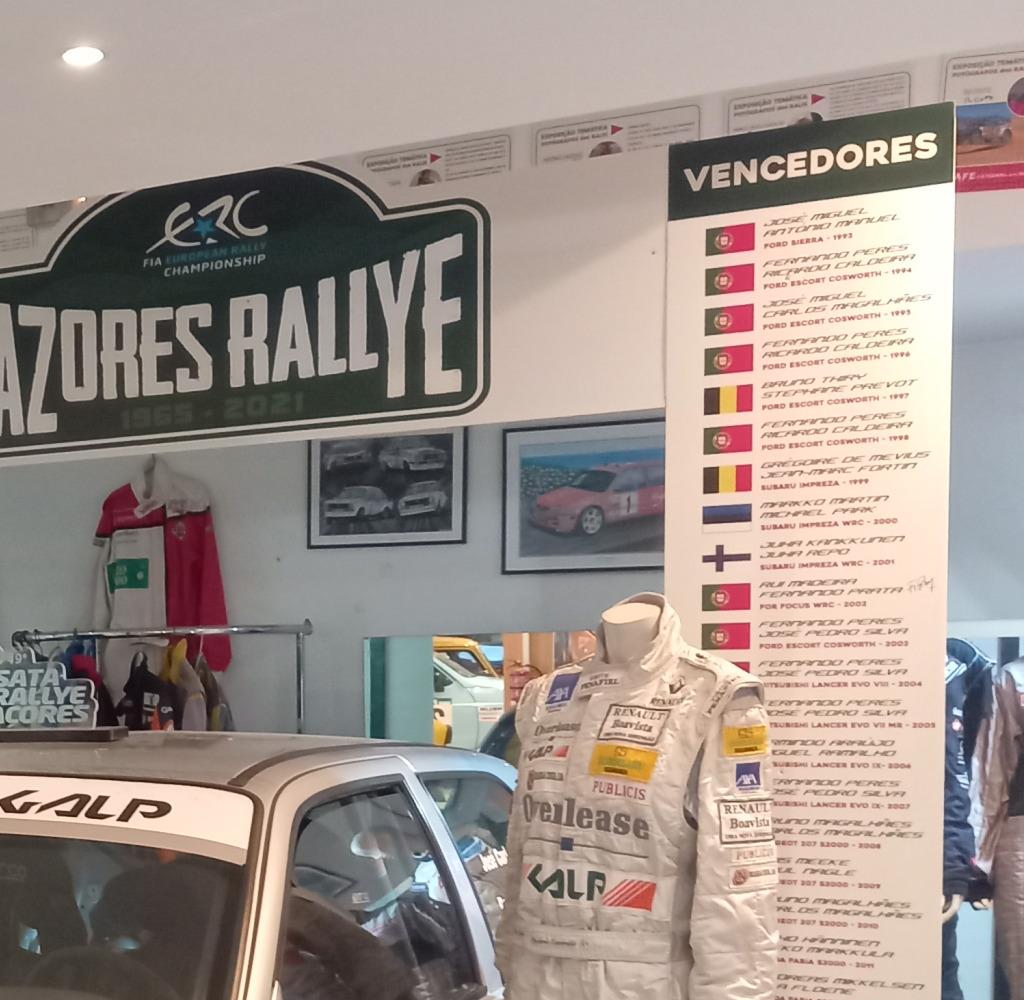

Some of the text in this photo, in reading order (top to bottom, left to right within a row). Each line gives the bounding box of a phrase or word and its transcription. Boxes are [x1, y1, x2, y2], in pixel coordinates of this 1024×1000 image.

[683, 133, 938, 191] VENCEDORES
[811, 208, 868, 220] MIGUEL
[835, 214, 900, 228] MANUEL
[791, 237, 823, 245] SIERRA
[143, 241, 267, 268] FIA EUROPEAN RALLY
[763, 244, 910, 267] FERNANDO PERES
[164, 254, 266, 277] CHAMPIONSHIP
[763, 254, 916, 278] RICARDO CALDEIRA
[764, 282, 787, 290] FORD
[791, 278, 825, 286] ESCORT
[829, 271, 881, 282] COSWORTH
[810, 291, 866, 303] MIGUEL
[227, 232, 463, 400] RALLYE
[763, 306, 826, 318] CARLOS
[790, 318, 825, 327] ESCORT
[828, 312, 880, 323] COSWORTH
[762, 328, 909, 348] FERNANDO PERES
[762, 338, 914, 359] RICARDO CALDEIRA
[828, 354, 880, 365] COSWORTH
[761, 378, 816, 389] BRUNO
[850, 379, 919, 391] PREVOT
[827, 395, 879, 405] COSWORTH
[761, 411, 907, 429] FERNANDO PERES
[842, 456, 866, 464] DE
[761, 483, 796, 491] SUBARU
[799, 480, 839, 488] IMPREZA
[829, 495, 889, 505] MARTIN
[832, 506, 876, 515] PARK
[761, 523, 796, 531] SUBARU
[760, 536, 905, 548] JUHA KANKKUNEN
[760, 548, 850, 558] JUHA REPO
[787, 579, 857, 587] MADEIRA
[759, 587, 903, 598] FERNANDO PRATA
[805, 629, 860, 637] PEDRO
[613, 708, 665, 721] RENAULT
[593, 781, 646, 800] PUBLICIS
